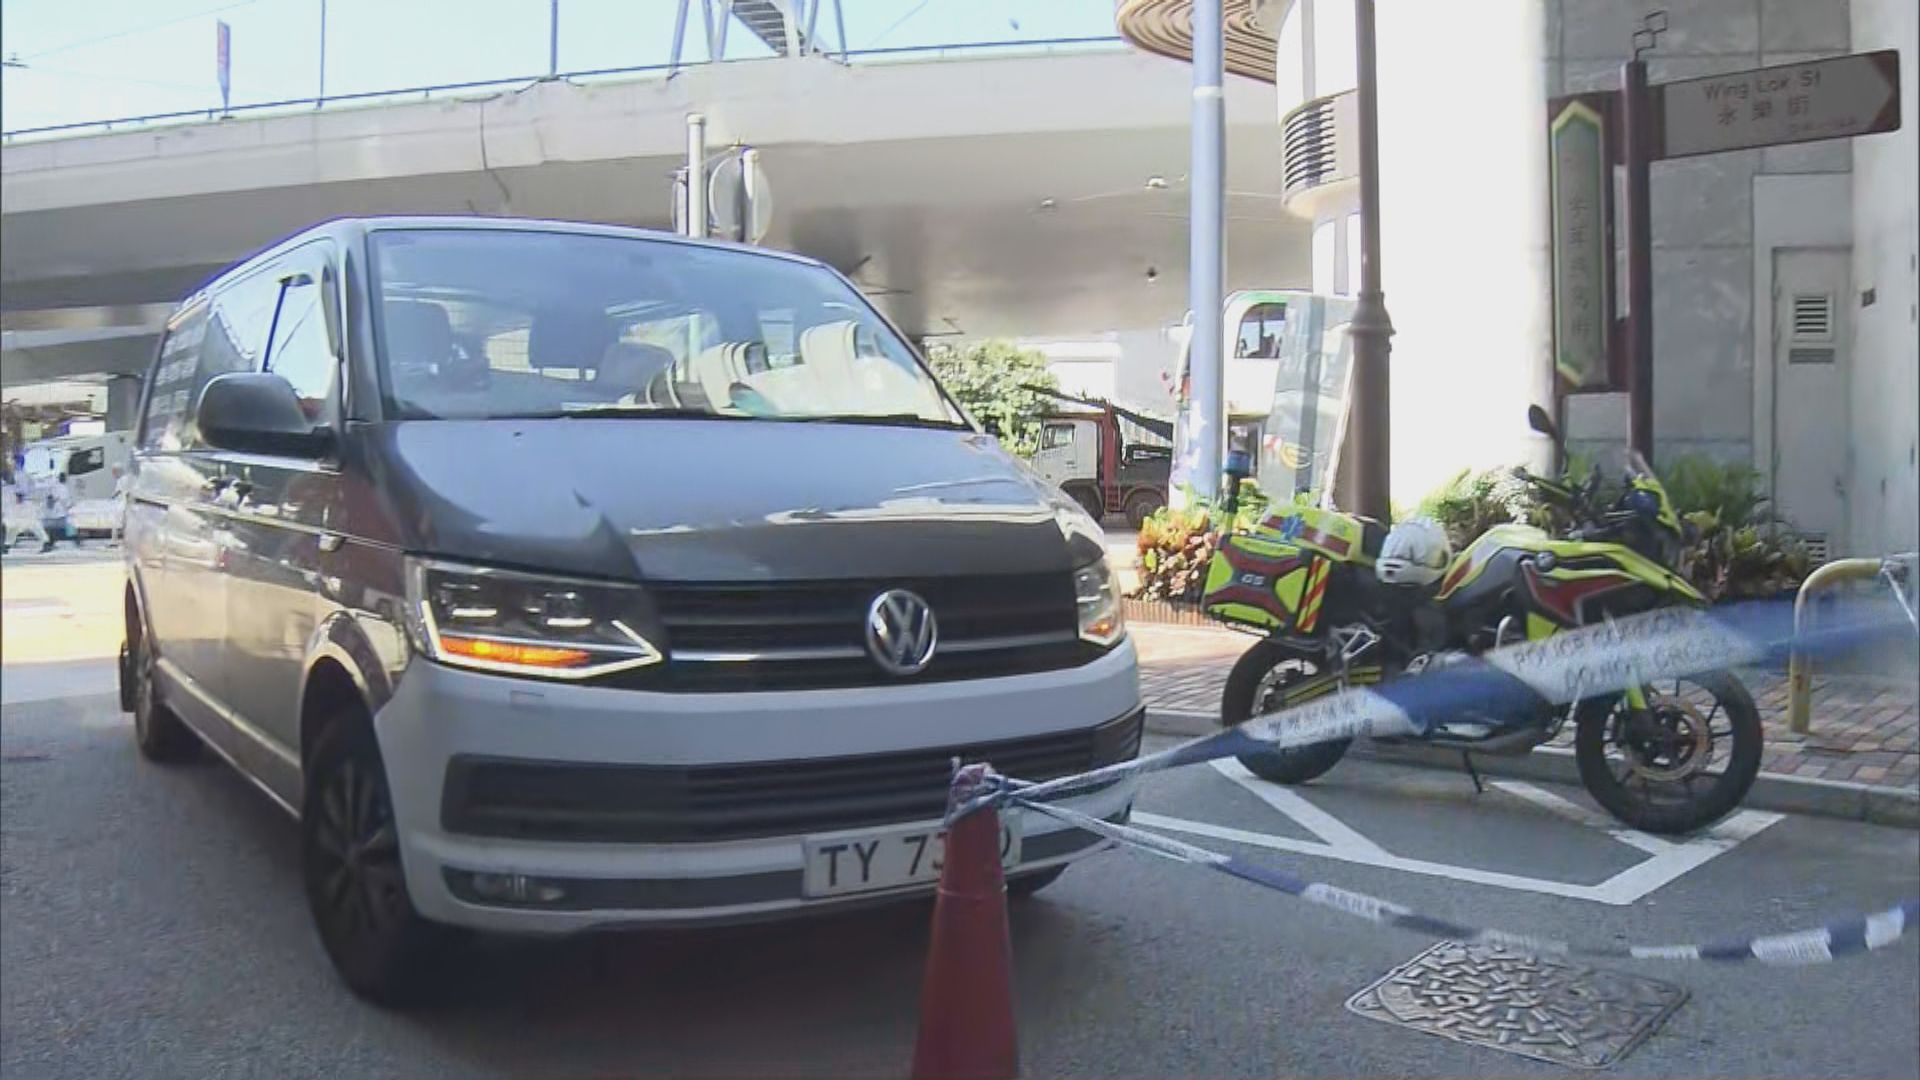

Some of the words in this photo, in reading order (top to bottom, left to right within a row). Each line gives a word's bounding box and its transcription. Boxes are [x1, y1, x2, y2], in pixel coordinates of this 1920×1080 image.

[1703, 80, 1749, 101] Wing
[1800, 67, 1822, 87] St
[819, 840, 880, 887] TY
